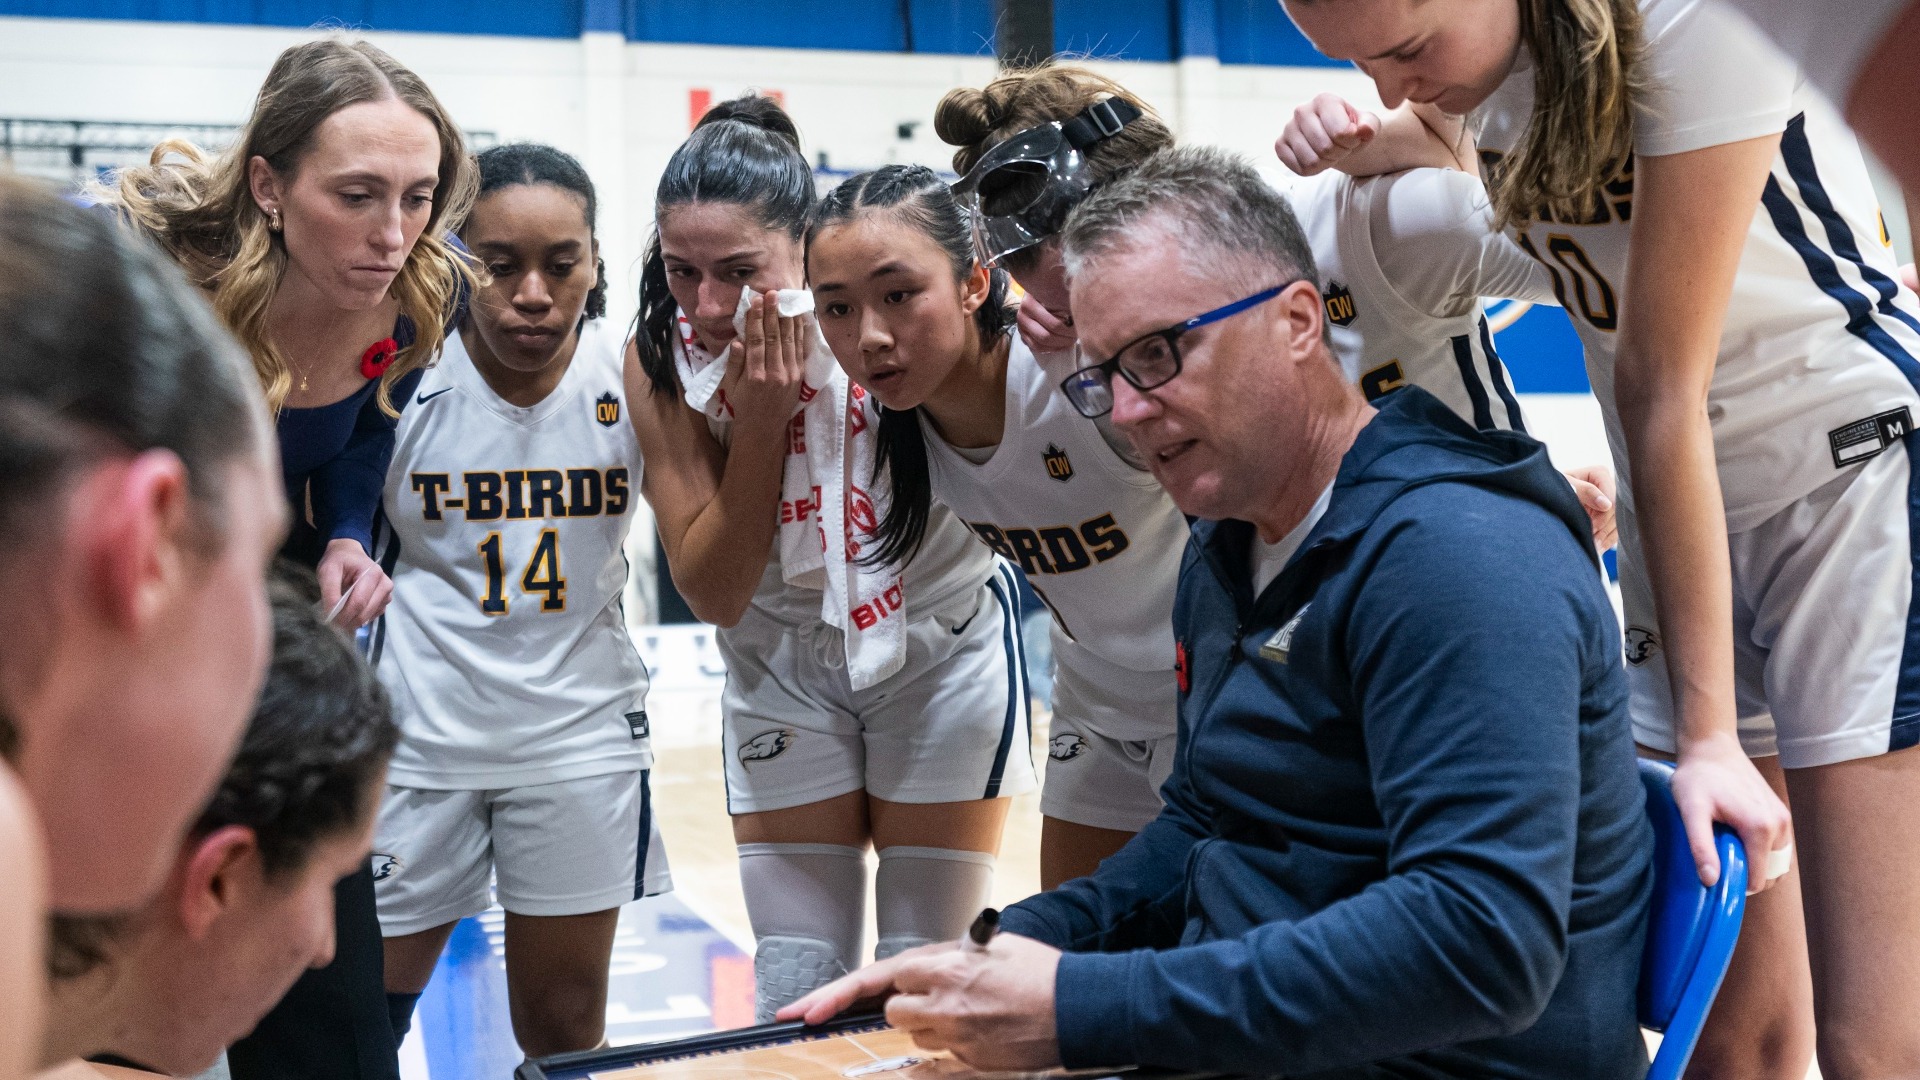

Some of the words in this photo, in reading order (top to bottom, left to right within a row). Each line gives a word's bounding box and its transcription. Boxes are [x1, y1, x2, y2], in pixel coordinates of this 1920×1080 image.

[1326, 294, 1353, 321] CW
[597, 403, 619, 422] CW
[1886, 421, 1904, 438] M
[1047, 455, 1070, 477] CW
[411, 467, 630, 522] T-BIRDS
[477, 527, 568, 616] 14
